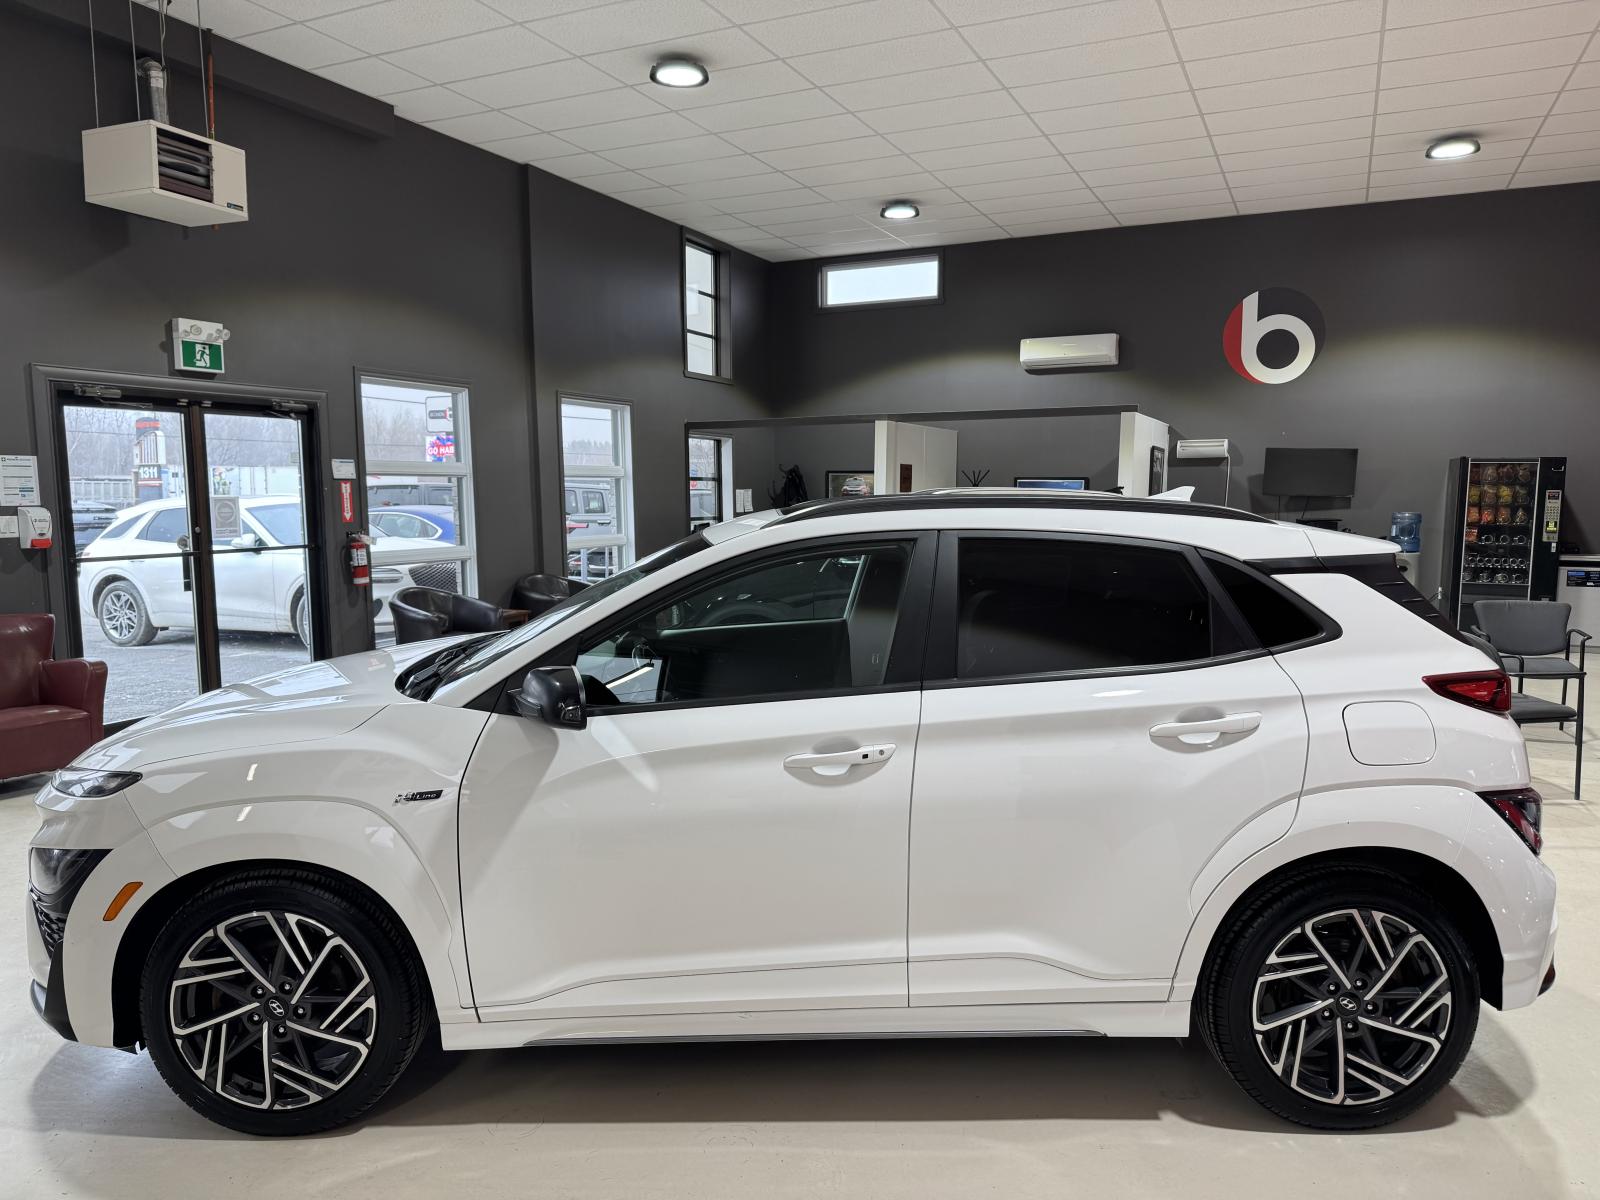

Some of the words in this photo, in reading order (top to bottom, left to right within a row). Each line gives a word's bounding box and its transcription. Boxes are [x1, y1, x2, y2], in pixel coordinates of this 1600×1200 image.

[1241, 291, 1315, 384] b
[428, 447, 439, 455] GO
[139, 466, 158, 479] 1311
